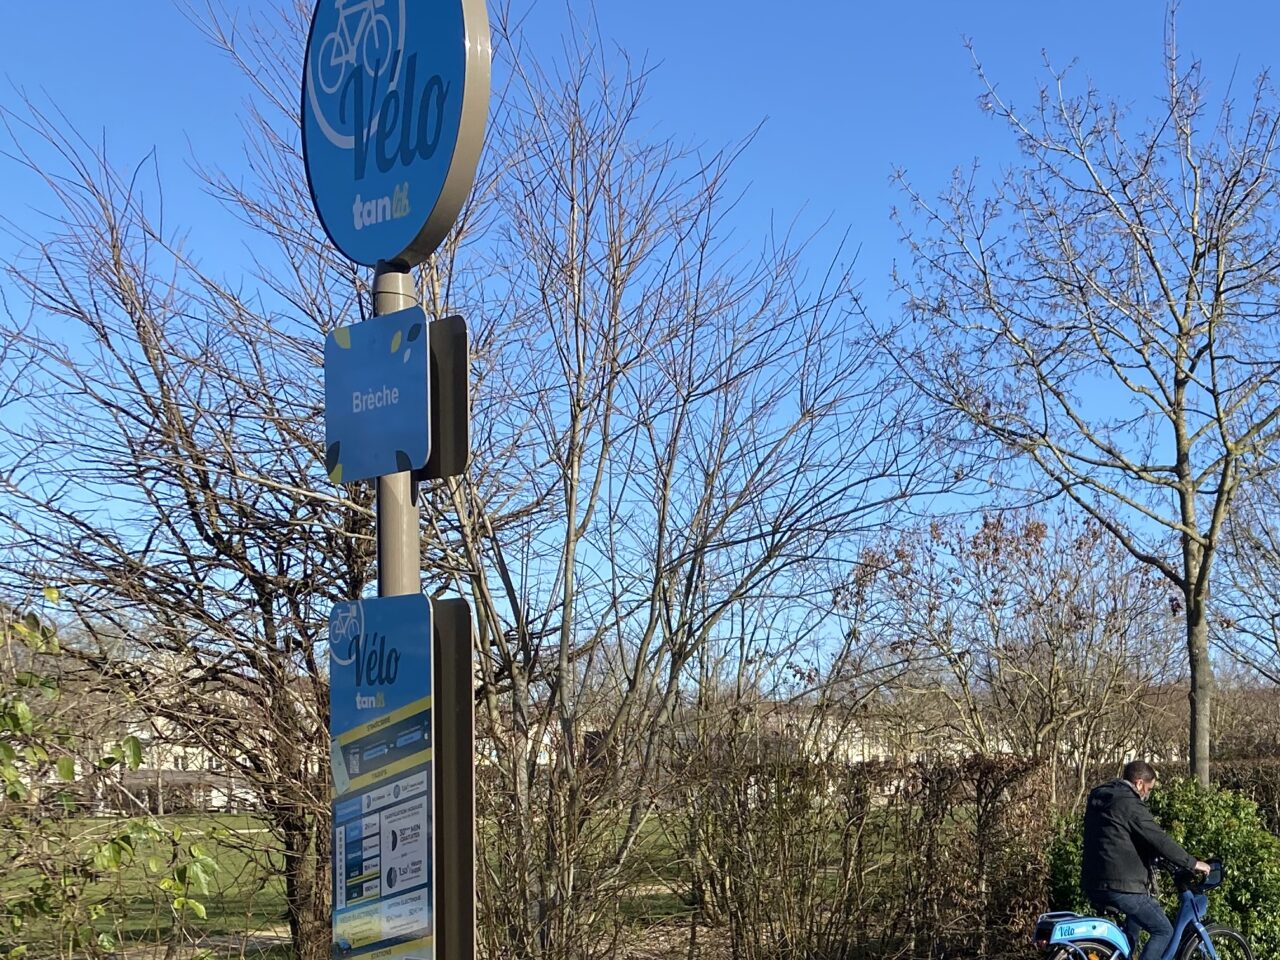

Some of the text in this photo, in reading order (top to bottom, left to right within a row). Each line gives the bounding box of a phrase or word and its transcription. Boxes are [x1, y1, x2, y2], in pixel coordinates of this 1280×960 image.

[339, 49, 451, 181] Vélo
[352, 385, 399, 413] Brèche
[348, 632, 401, 687] Vélo
[1058, 925, 1075, 937] Vélo
